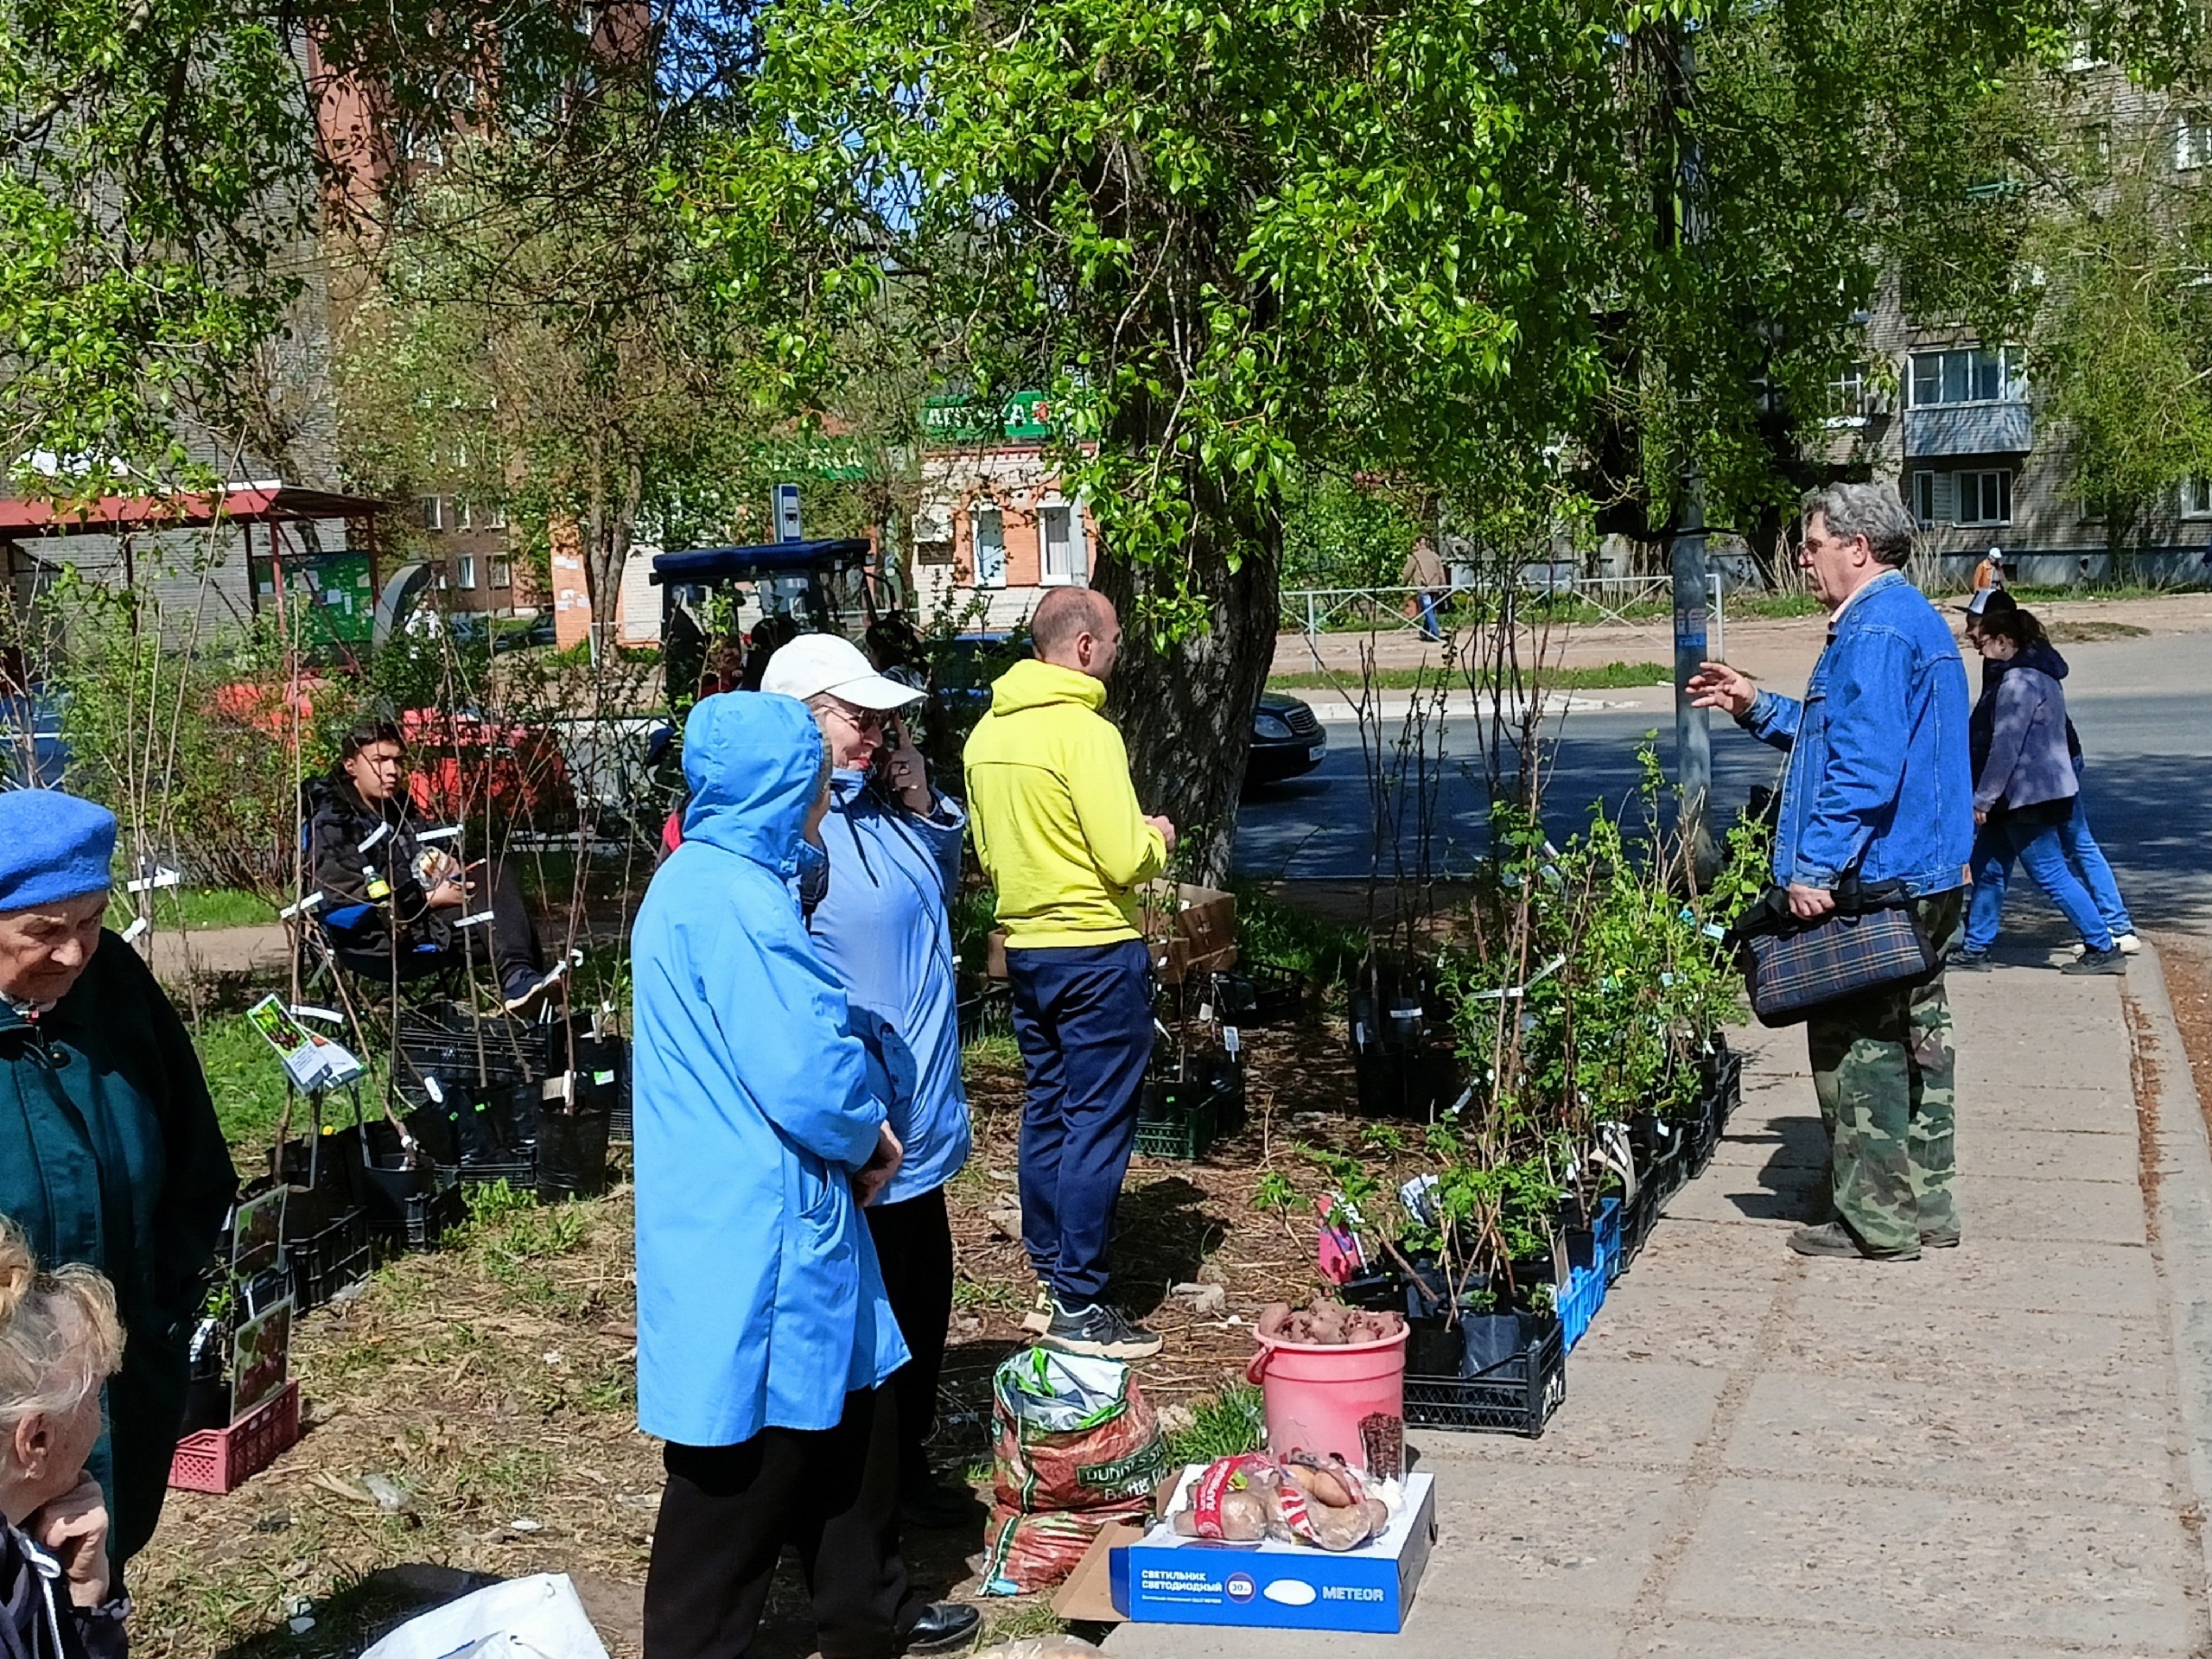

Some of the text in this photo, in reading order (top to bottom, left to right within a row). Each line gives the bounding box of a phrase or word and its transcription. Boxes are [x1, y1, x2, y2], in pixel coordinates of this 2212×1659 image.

[1104, 1477, 1150, 1501] Better
[1141, 1570, 1206, 1581] СВЕТИЛЬНИК
[1141, 1580, 1223, 1593] СВЕТОДИОДНЫЙ
[1322, 1586, 1384, 1602] METEOR
